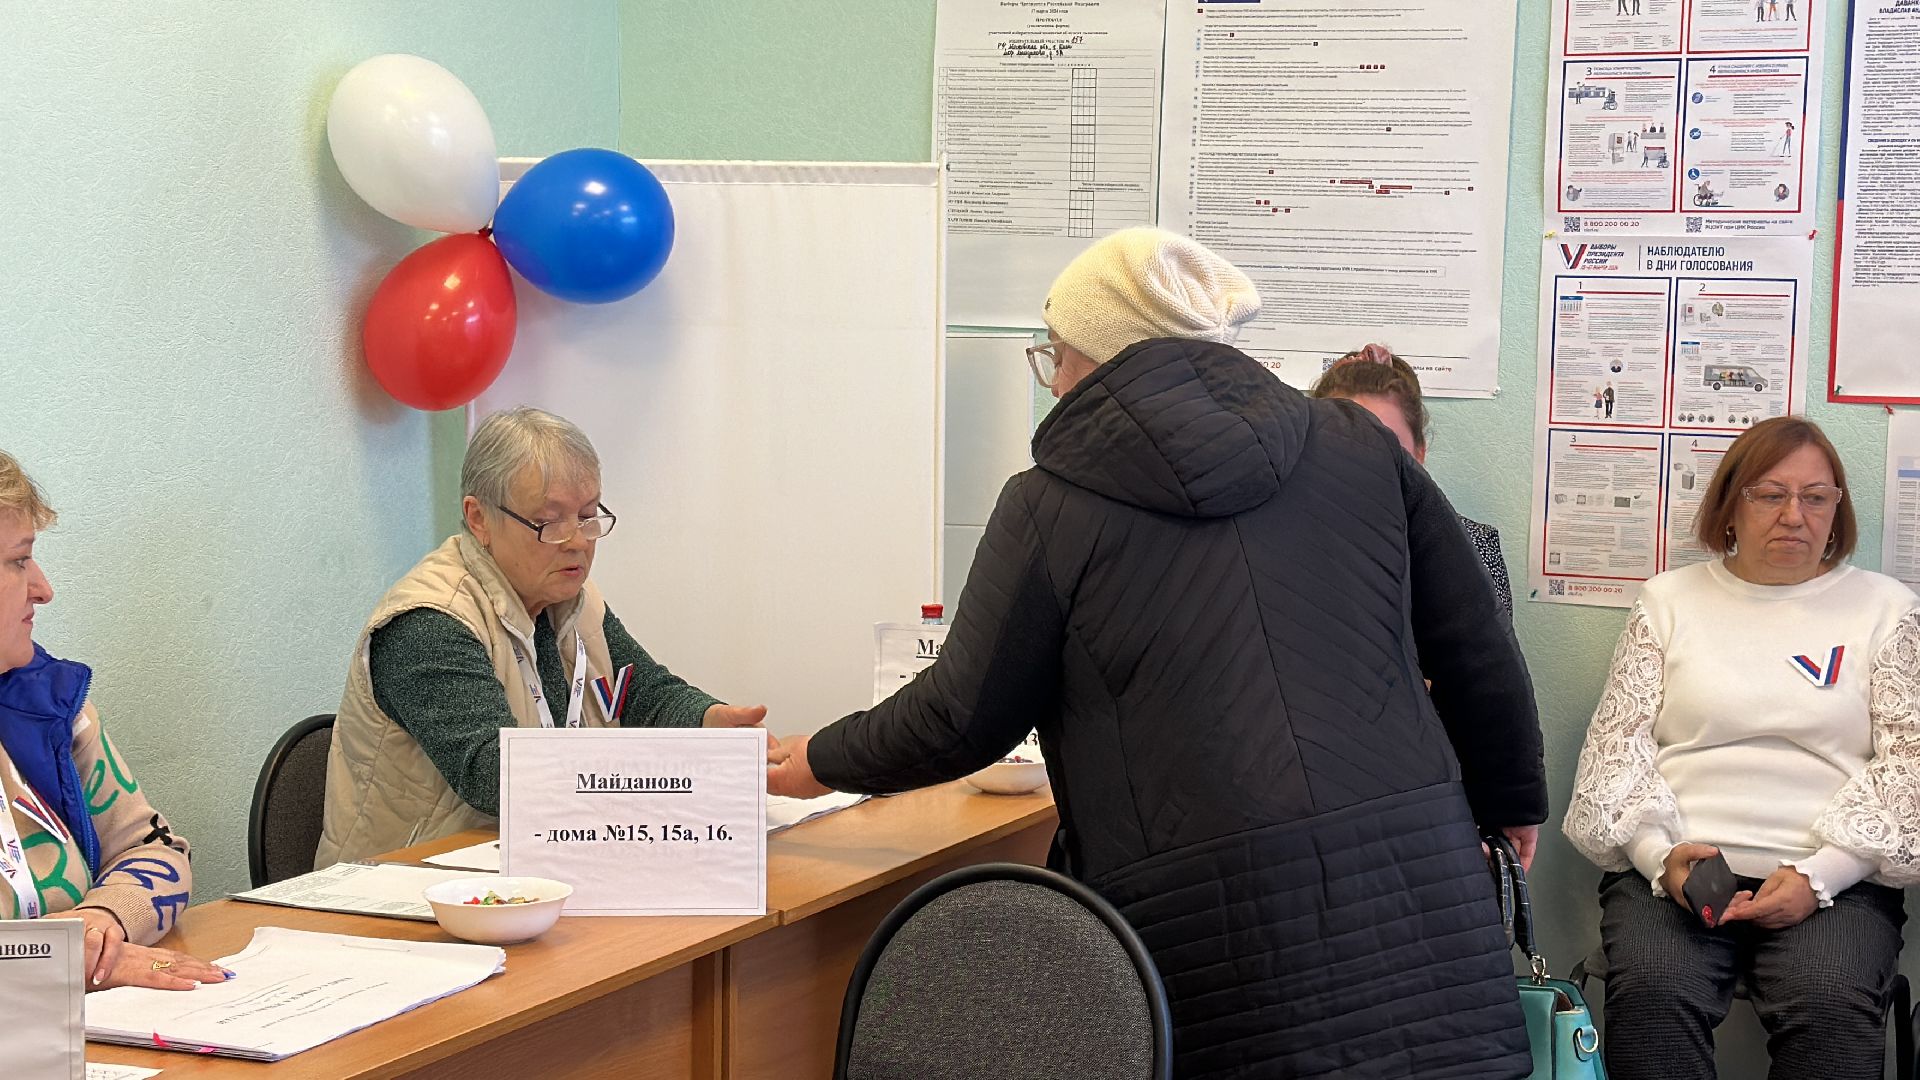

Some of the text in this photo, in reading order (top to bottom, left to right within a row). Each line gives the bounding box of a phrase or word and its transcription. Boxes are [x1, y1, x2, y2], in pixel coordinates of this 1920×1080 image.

[1586, 66, 1592, 76] 3
[1709, 65, 1716, 74] 4
[1647, 246, 1725, 258] НАБЛЮДАТЕЛЮ
[1647, 260, 1753, 271] В ДНИ ГОЛОСОВАНИЯ
[1699, 283, 1706, 291] 2
[1570, 434, 1577, 443] 3
[1691, 439, 1698, 447] 4
[575, 773, 693, 792] Майданово
[547, 829, 598, 844] дома
[602, 824, 655, 844] №15,
[661, 824, 699, 844] 15а,
[706, 824, 735, 842] 16.
